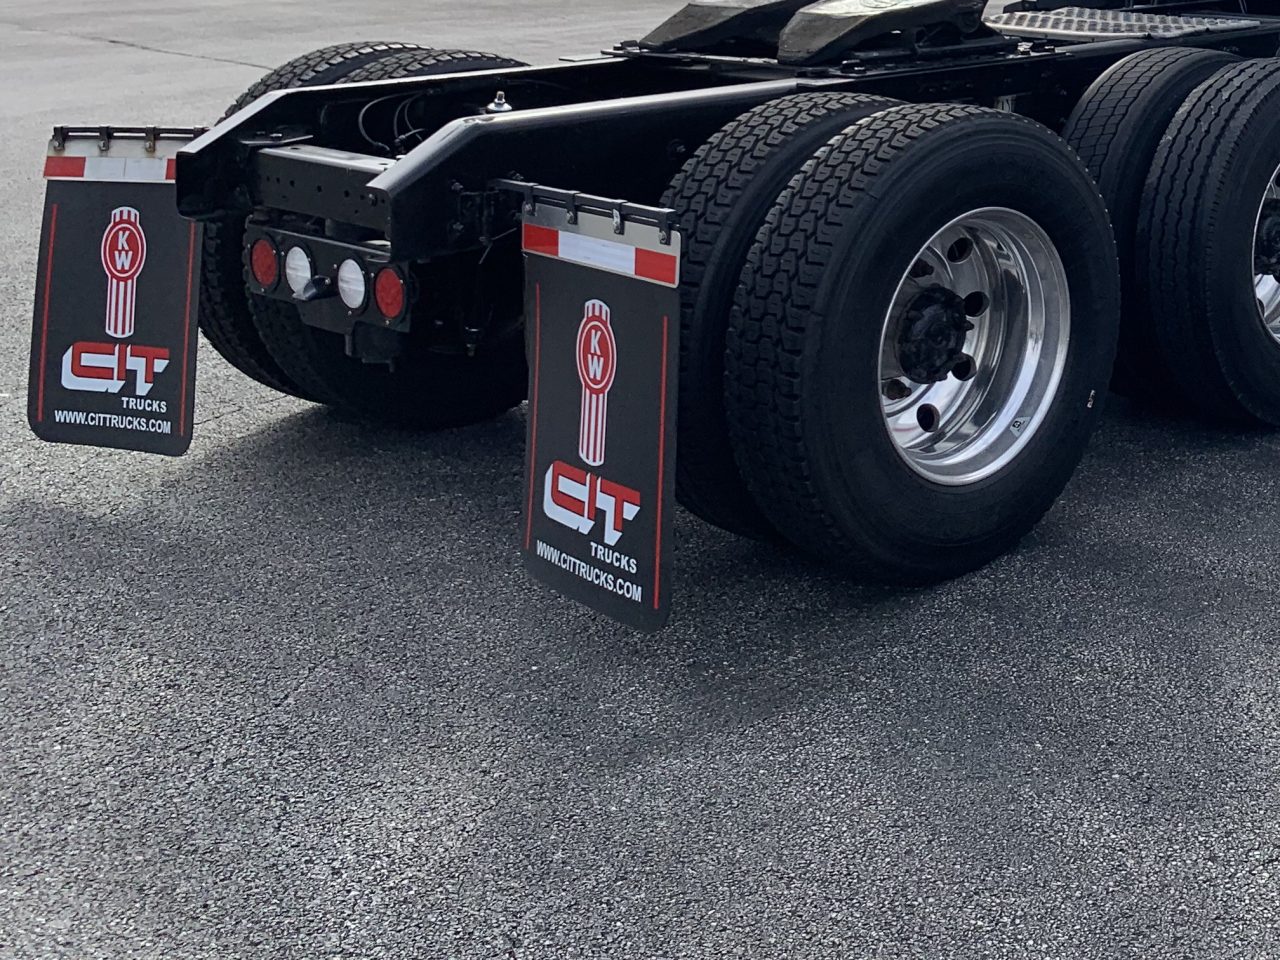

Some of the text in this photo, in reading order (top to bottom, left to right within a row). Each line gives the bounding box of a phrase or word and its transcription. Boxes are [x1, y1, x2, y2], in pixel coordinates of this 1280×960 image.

[62, 341, 170, 396] CIT
[54, 409, 172, 434] WWW.CITTRUCKS.COM
[121, 396, 167, 413] TRUCKS
[543, 460, 641, 547] CIT
[536, 540, 642, 602] WWW.CITTRUCKS.COM
[590, 541, 638, 574] TRUCKS
